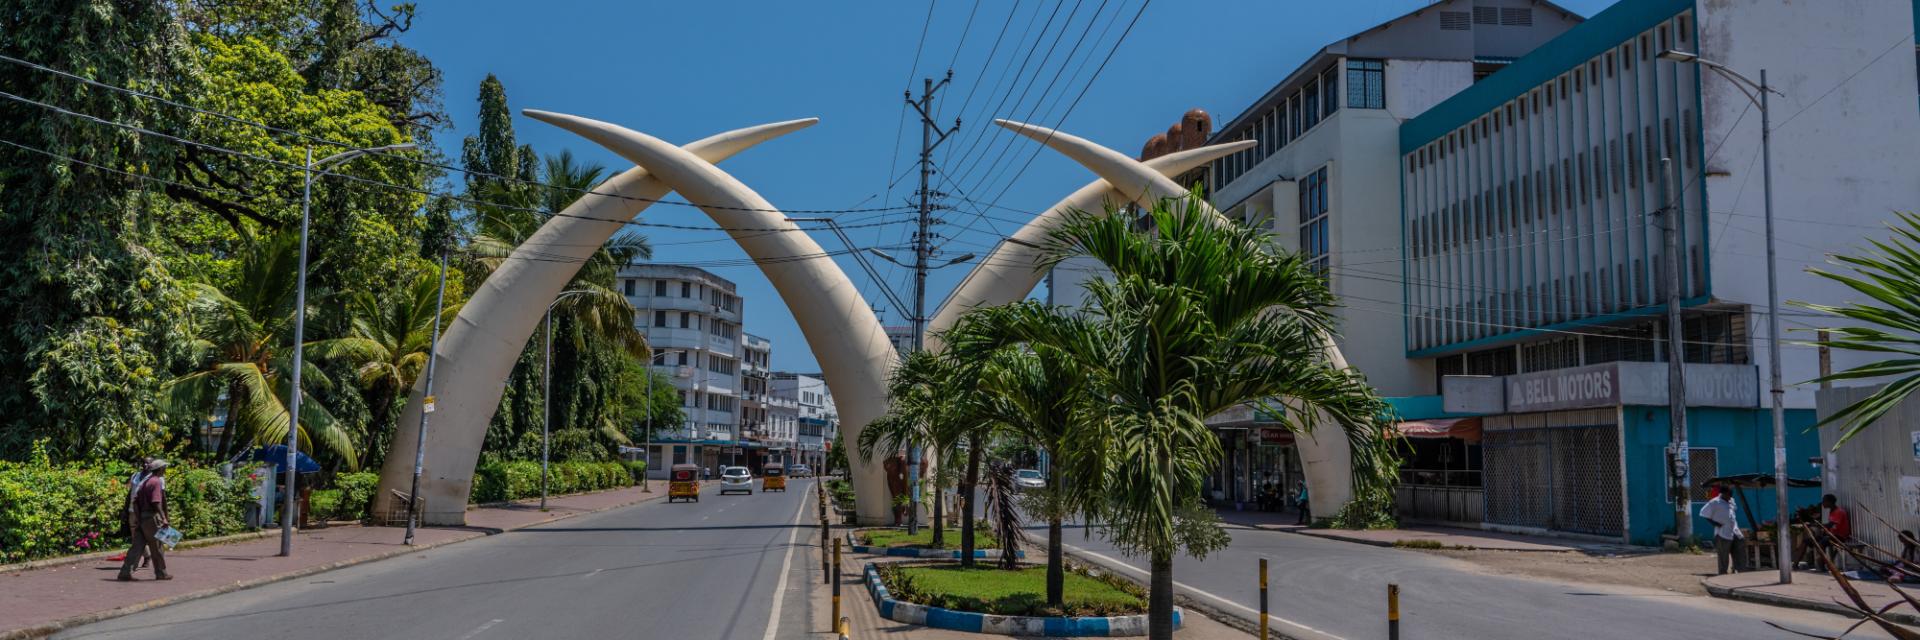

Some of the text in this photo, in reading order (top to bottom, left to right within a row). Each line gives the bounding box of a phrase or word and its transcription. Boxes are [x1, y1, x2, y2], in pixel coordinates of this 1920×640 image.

[1525, 370, 1612, 405] BELL MOTORS
[1691, 371, 1753, 401] MOTORS
